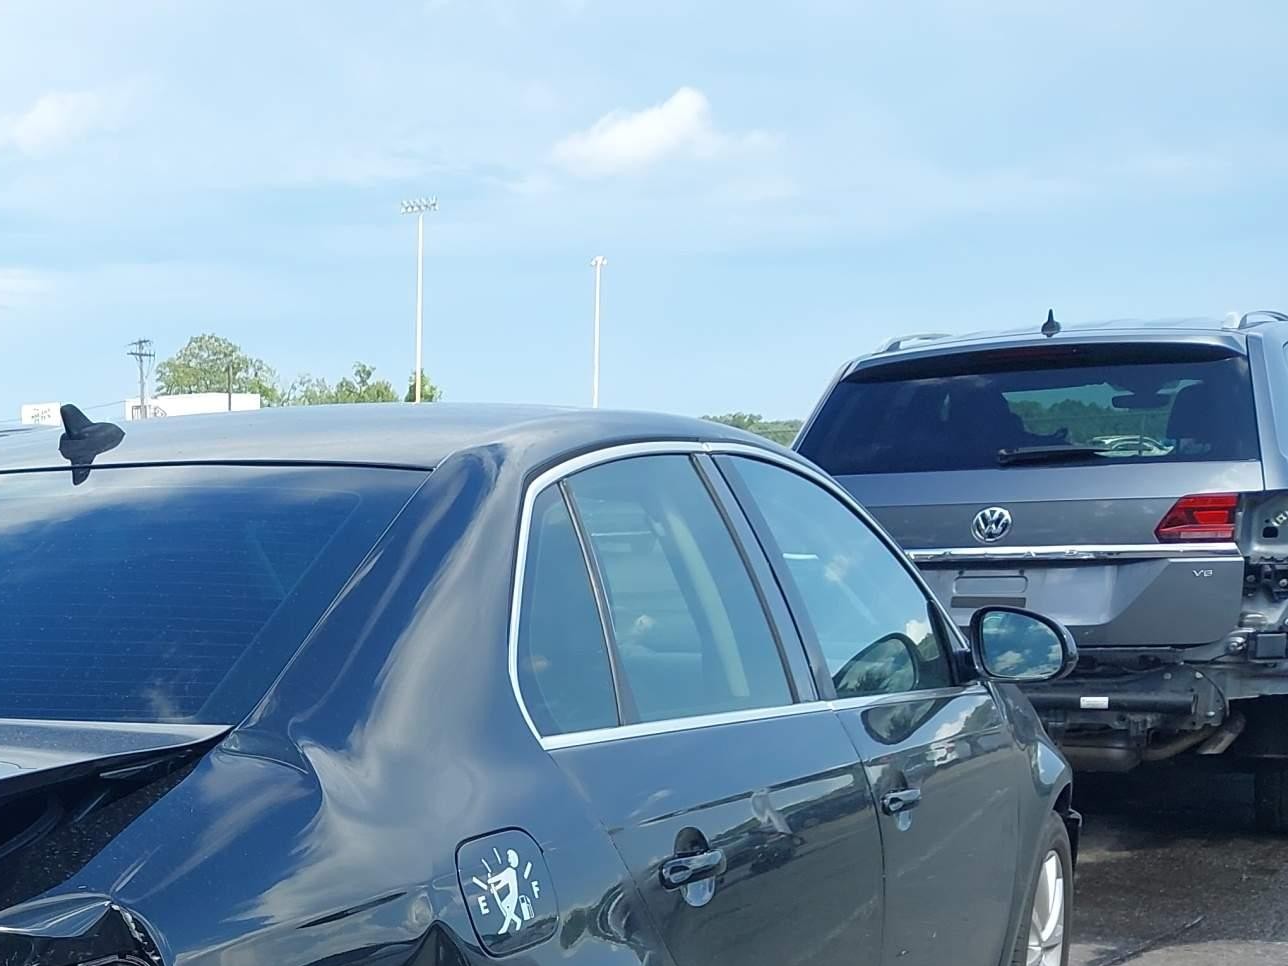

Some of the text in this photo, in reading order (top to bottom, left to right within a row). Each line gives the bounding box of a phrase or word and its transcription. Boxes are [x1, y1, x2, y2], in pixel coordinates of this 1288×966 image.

[971, 506, 1012, 544] VW
[531, 880, 540, 899] F
[477, 895, 490, 915] E
